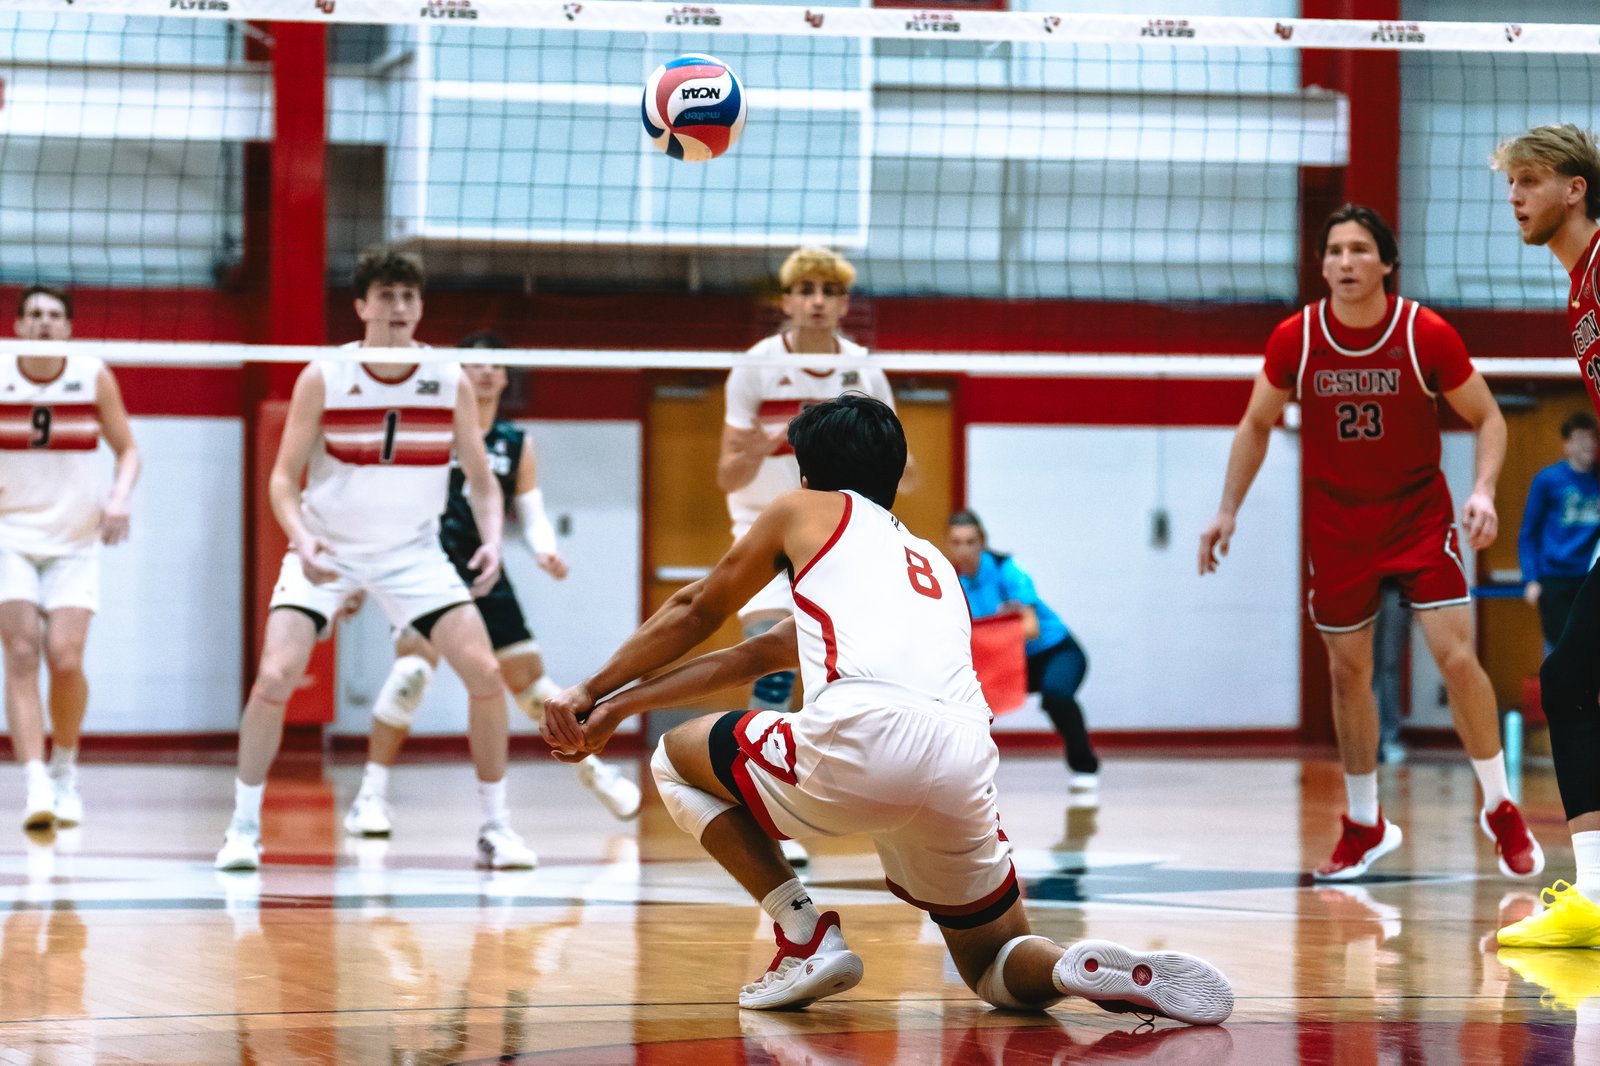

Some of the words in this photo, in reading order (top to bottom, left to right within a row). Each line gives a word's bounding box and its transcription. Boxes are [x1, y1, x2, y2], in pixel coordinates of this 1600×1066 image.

[681, 87, 721, 100] NCAA
[684, 111, 721, 121] molten
[1313, 368, 1401, 397] CSUN
[31, 404, 52, 449] 9
[381, 409, 399, 464] 1
[1335, 401, 1384, 441] 23
[904, 546, 943, 600] 8
